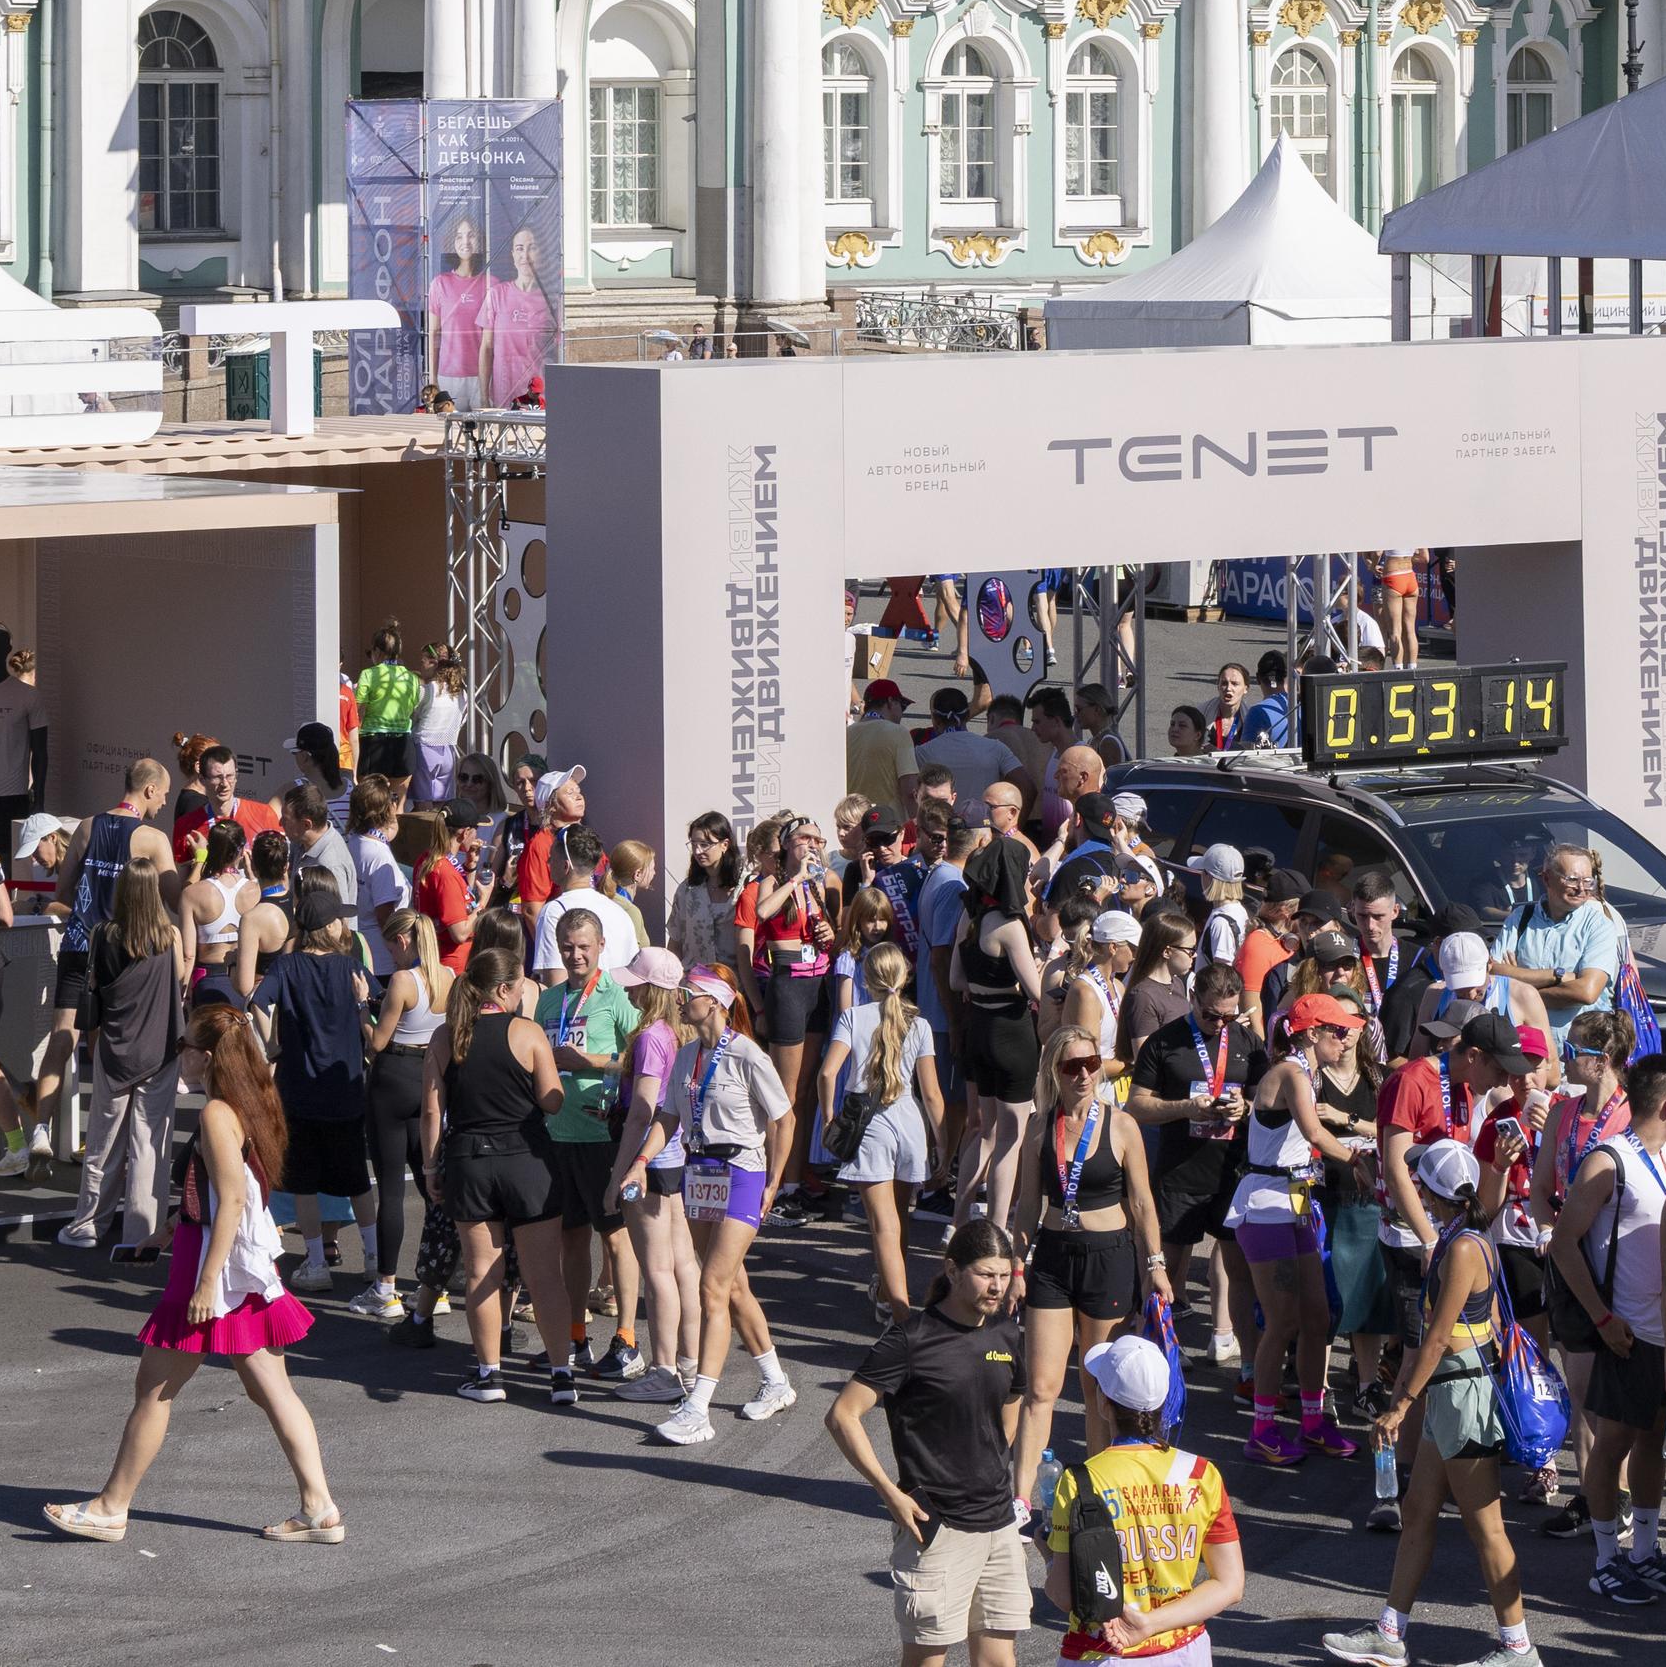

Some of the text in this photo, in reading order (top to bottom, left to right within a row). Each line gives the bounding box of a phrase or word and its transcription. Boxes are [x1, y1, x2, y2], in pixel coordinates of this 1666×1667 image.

[437, 115, 512, 130] БЕГАЕШЬ
[437, 133, 469, 147] КАК
[437, 150, 526, 167] ДЕВЧОНКА
[374, 196, 393, 414] МАРФОН
[353, 329, 373, 414] ПОЛ
[1462, 428, 1552, 443] ОФИЦИАЛЬНЫЙ
[904, 446, 950, 458] НОВЫЙ
[1047, 426, 1398, 485] TENET
[1456, 445, 1557, 460] ПАРТНЕР ЗАБЕГА
[867, 459, 986, 476] АВТОМОБИЛЬНЫЙ
[905, 479, 950, 492] БРЕНД
[1067, 1161, 1084, 1196] 10 KM
[688, 1182, 728, 1202] 13730
[1122, 1484, 1182, 1499] SAMARA
[1126, 1503, 1183, 1518] MARATHON
[1095, 1570, 1110, 1594] DXB
